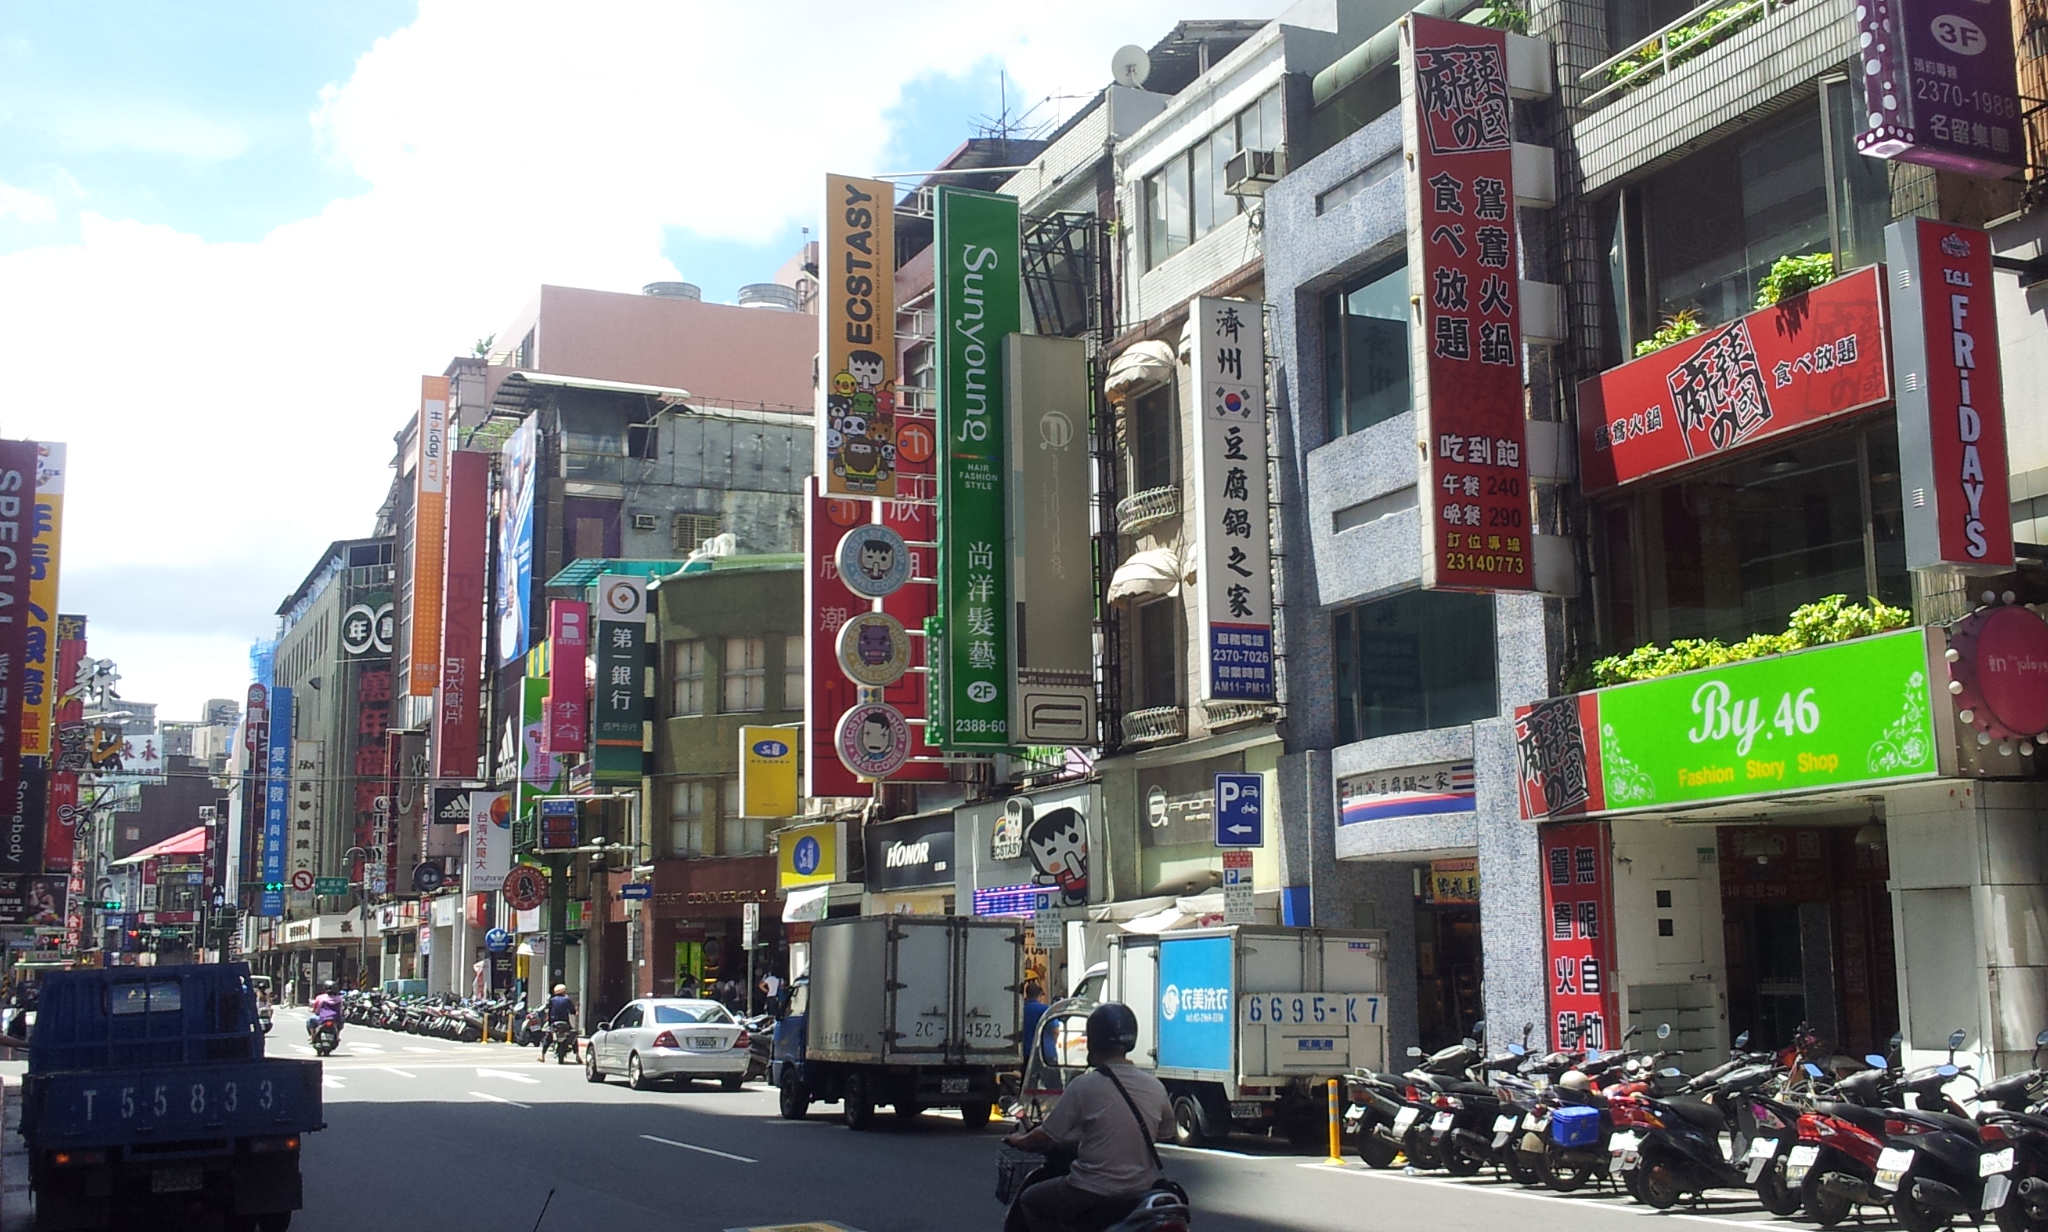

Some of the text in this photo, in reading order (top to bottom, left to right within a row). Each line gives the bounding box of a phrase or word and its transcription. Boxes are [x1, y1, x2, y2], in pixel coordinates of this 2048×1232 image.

[1938, 21, 1979, 48] 3F
[1915, 77, 2015, 119] 2370-1988
[1930, 114, 2010, 152] 名留集團
[845, 184, 873, 345] ECSTASY
[1428, 171, 1470, 361] 食べ放題
[1473, 176, 1515, 366] 鴛鴦火鍋
[955, 243, 998, 442] Sunyoung
[1216, 306, 1245, 380] 濟州
[1772, 335, 1857, 389] 食べ放題
[425, 411, 442, 482] Holiday KTV
[1440, 433, 1520, 468] 吃到飽
[959, 471, 998, 482] FASHION
[967, 463, 989, 473] HAIR
[964, 480, 993, 491] STYLE
[1442, 473, 1520, 497] 午餐 240
[1222, 426, 1254, 618] 豆腐鍋之家
[1443, 503, 1522, 528] 晚餐 290
[1447, 533, 1521, 552] 訂位專線
[1446, 553, 1525, 574] 23140773
[967, 541, 996, 670] 尚洋髮藝
[1217, 632, 1265, 647] 服務電話
[611, 627, 633, 711] 第一銀行
[1213, 649, 1269, 664] 2370-7026
[1218, 665, 1265, 680] 營業時間
[444, 657, 460, 725] 5大唱片
[971, 685, 993, 699] 2F
[1213, 680, 1271, 694] AM11-PM11
[955, 719, 1007, 733] 2388-60
[853, 750, 902, 772] WELCOME
[1678, 753, 1839, 788] Fashion Story Shop
[1220, 781, 1240, 812] P
[1379, 771, 1451, 796] 豆腐鍋之家
[7, 780, 28, 863] Somebody
[886, 841, 930, 868] HONOR
[991, 842, 1022, 860] ECSTASY
[1227, 870, 1236, 883] P
[687, 889, 768, 904] COMMERCIAL
[1038, 896, 1047, 907] P
[1249, 996, 1379, 1023] 6695-K7
